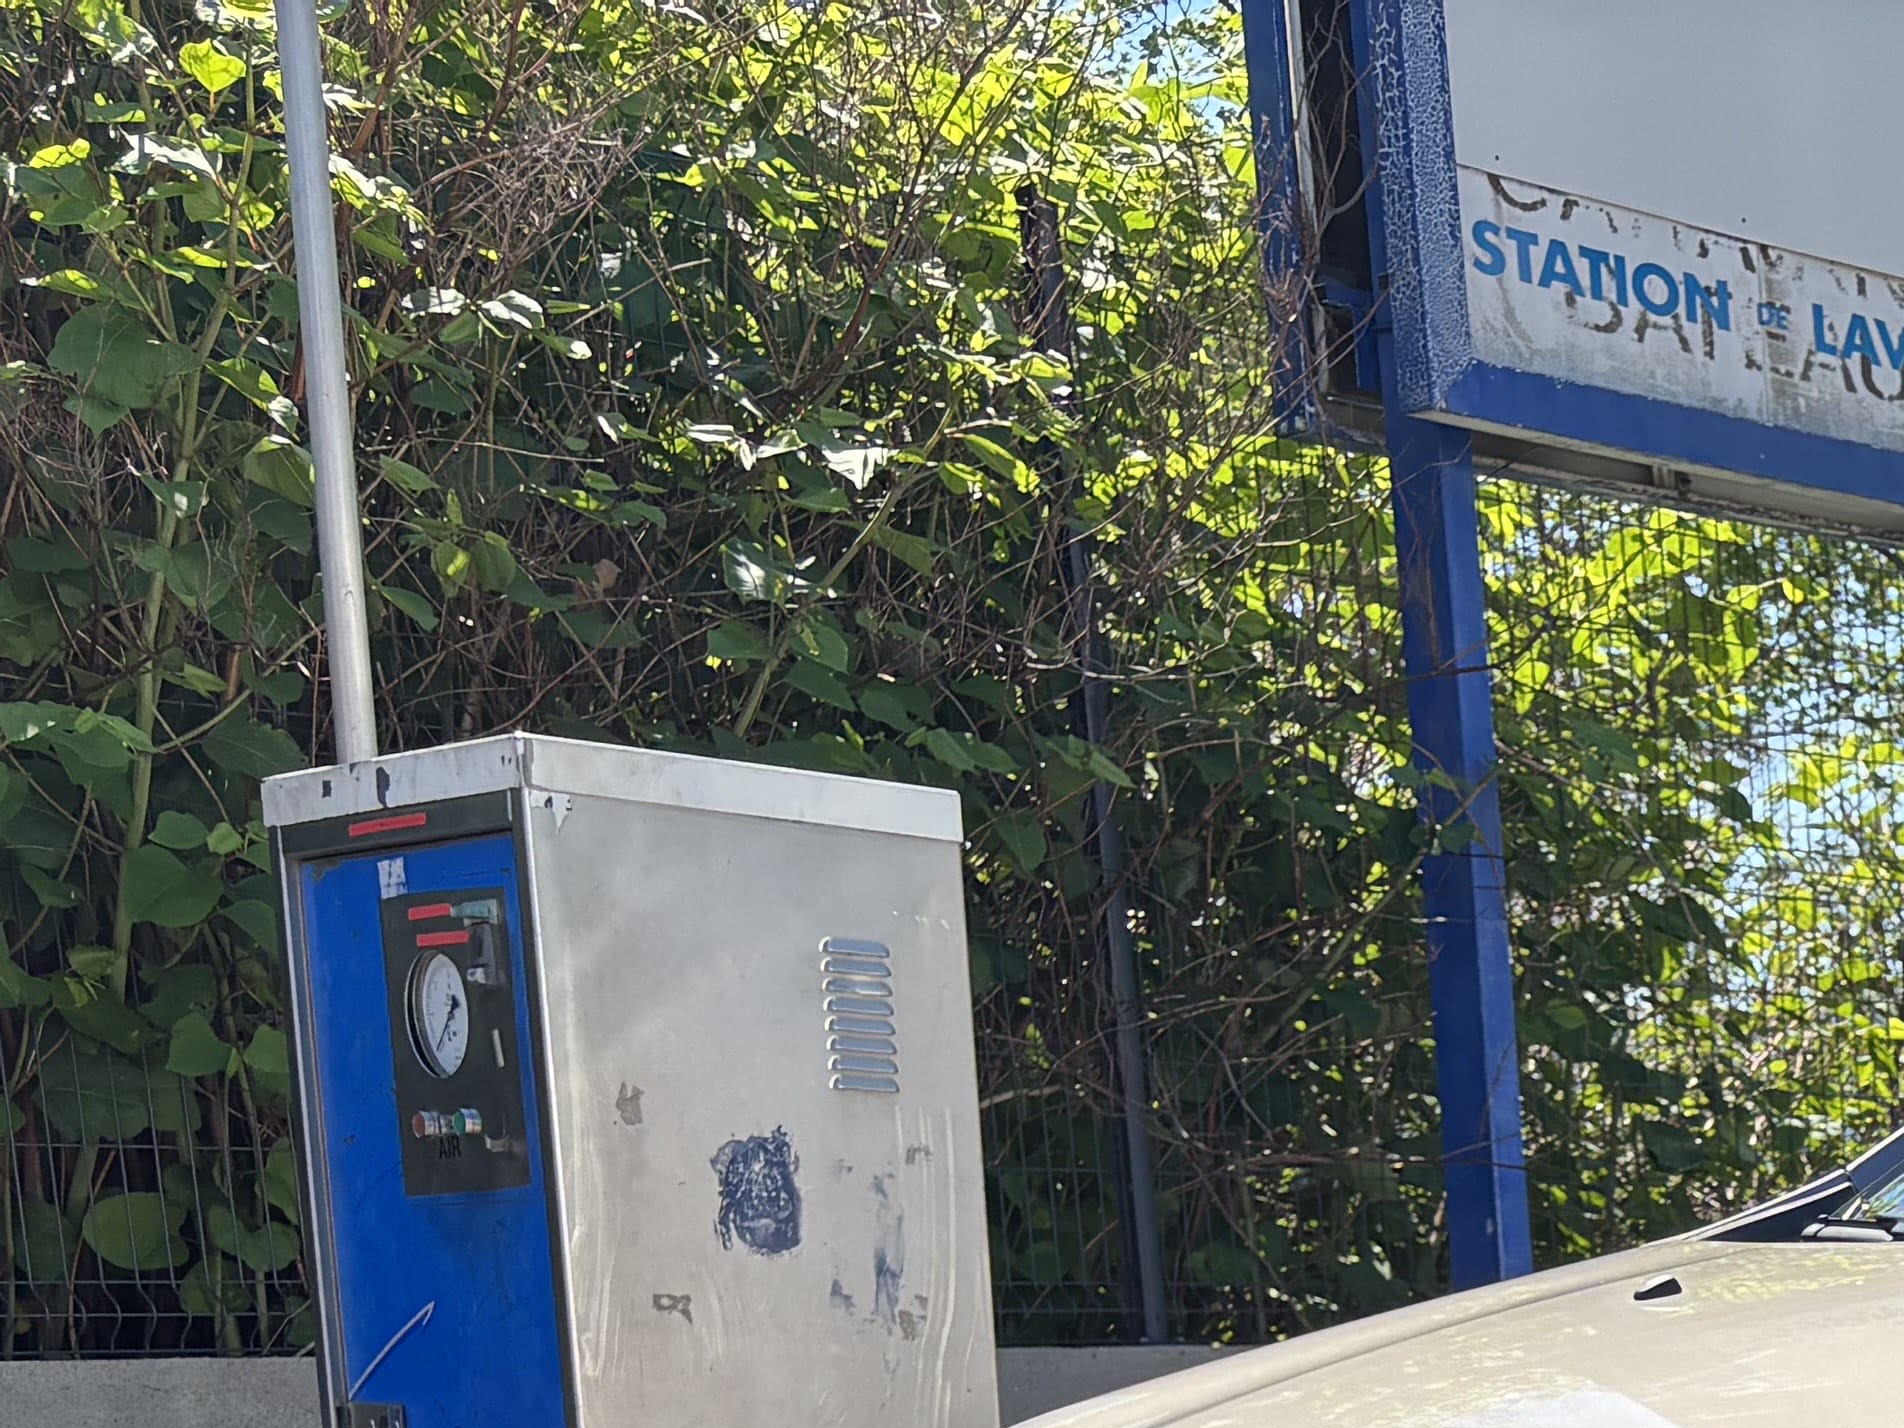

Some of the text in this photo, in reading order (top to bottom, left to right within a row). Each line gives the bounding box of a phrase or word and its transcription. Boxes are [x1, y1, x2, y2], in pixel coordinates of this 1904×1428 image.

[1471, 219, 1731, 332] STATION
[1757, 301, 1789, 331] DE
[439, 1133, 462, 1159] AIR
